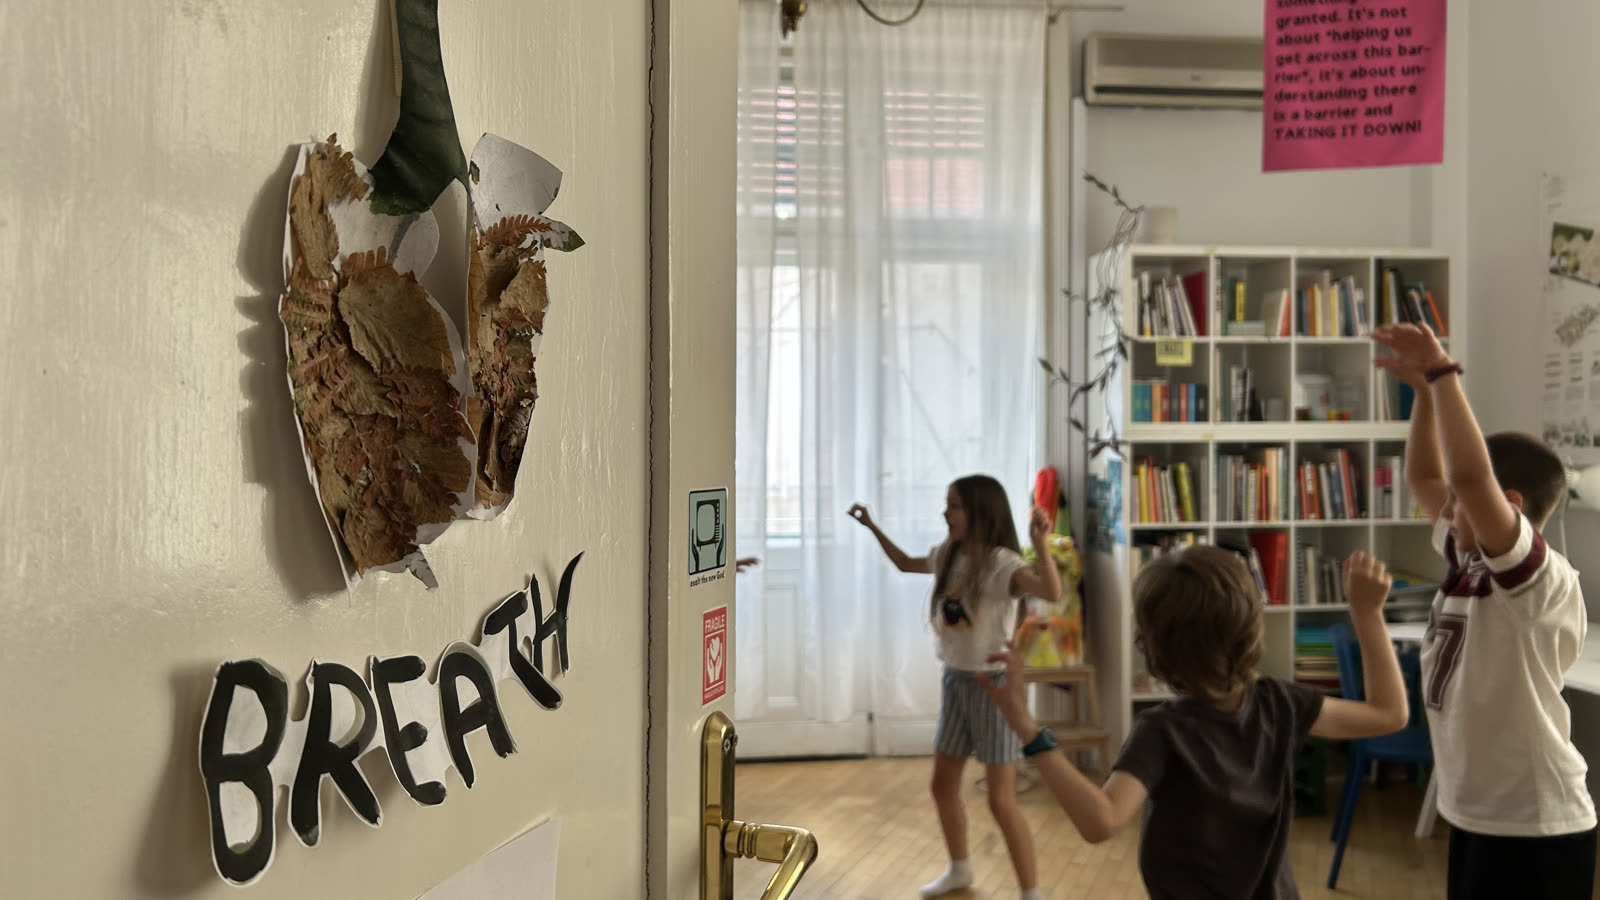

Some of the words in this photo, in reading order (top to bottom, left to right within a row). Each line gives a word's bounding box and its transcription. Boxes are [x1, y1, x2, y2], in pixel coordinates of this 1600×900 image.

[1276, 11, 1340, 29] granted.
[1348, 8, 1374, 20] It's
[1380, 7, 1406, 18] not
[1276, 33, 1319, 45] about
[1395, 26, 1412, 36] us
[1275, 52, 1301, 67] get
[1306, 51, 1357, 62] across
[1364, 46, 1392, 59] this
[1397, 43, 1430, 56] bar-
[1319, 68, 1344, 81] it's
[1349, 64, 1395, 79] about
[1401, 65, 1427, 76] un-
[1275, 86, 1367, 100] derstanding
[1373, 83, 1417, 96] there
[1274, 109, 1286, 122] is
[1291, 110, 1300, 121] a
[1304, 106, 1358, 120] barrier
[1364, 103, 1394, 117] and
[1274, 125, 1336, 141] TAKING
[1341, 124, 1358, 138] IT
[1363, 120, 1421, 136] DOWN!
[704, 614, 725, 633] FRAGILE
[201, 551, 584, 882] BREATH
